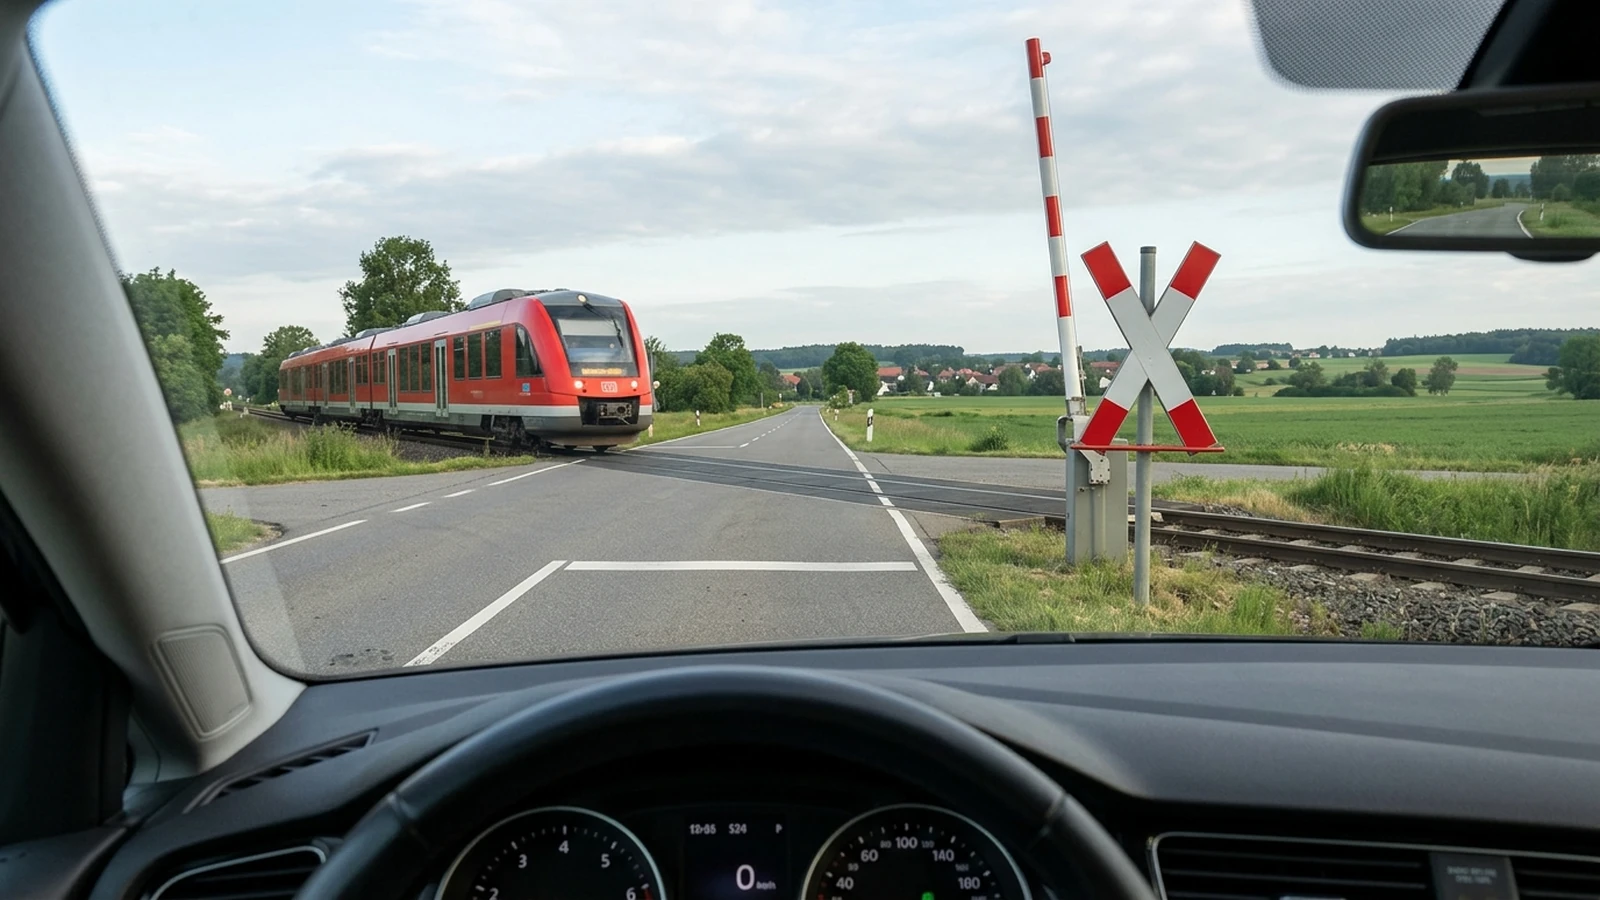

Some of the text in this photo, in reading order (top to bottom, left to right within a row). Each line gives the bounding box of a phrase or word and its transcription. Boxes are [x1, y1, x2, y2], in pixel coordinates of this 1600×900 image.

[558, 840, 569, 854] 4
[895, 836, 918, 849] 100
[517, 854, 528, 868] 3
[600, 853, 611, 868] 5
[860, 849, 879, 862] 60
[932, 849, 955, 862] 140
[736, 864, 755, 891] 0
[836, 877, 854, 890] 40
[488, 887, 499, 900] 2
[626, 887, 637, 900] 6
